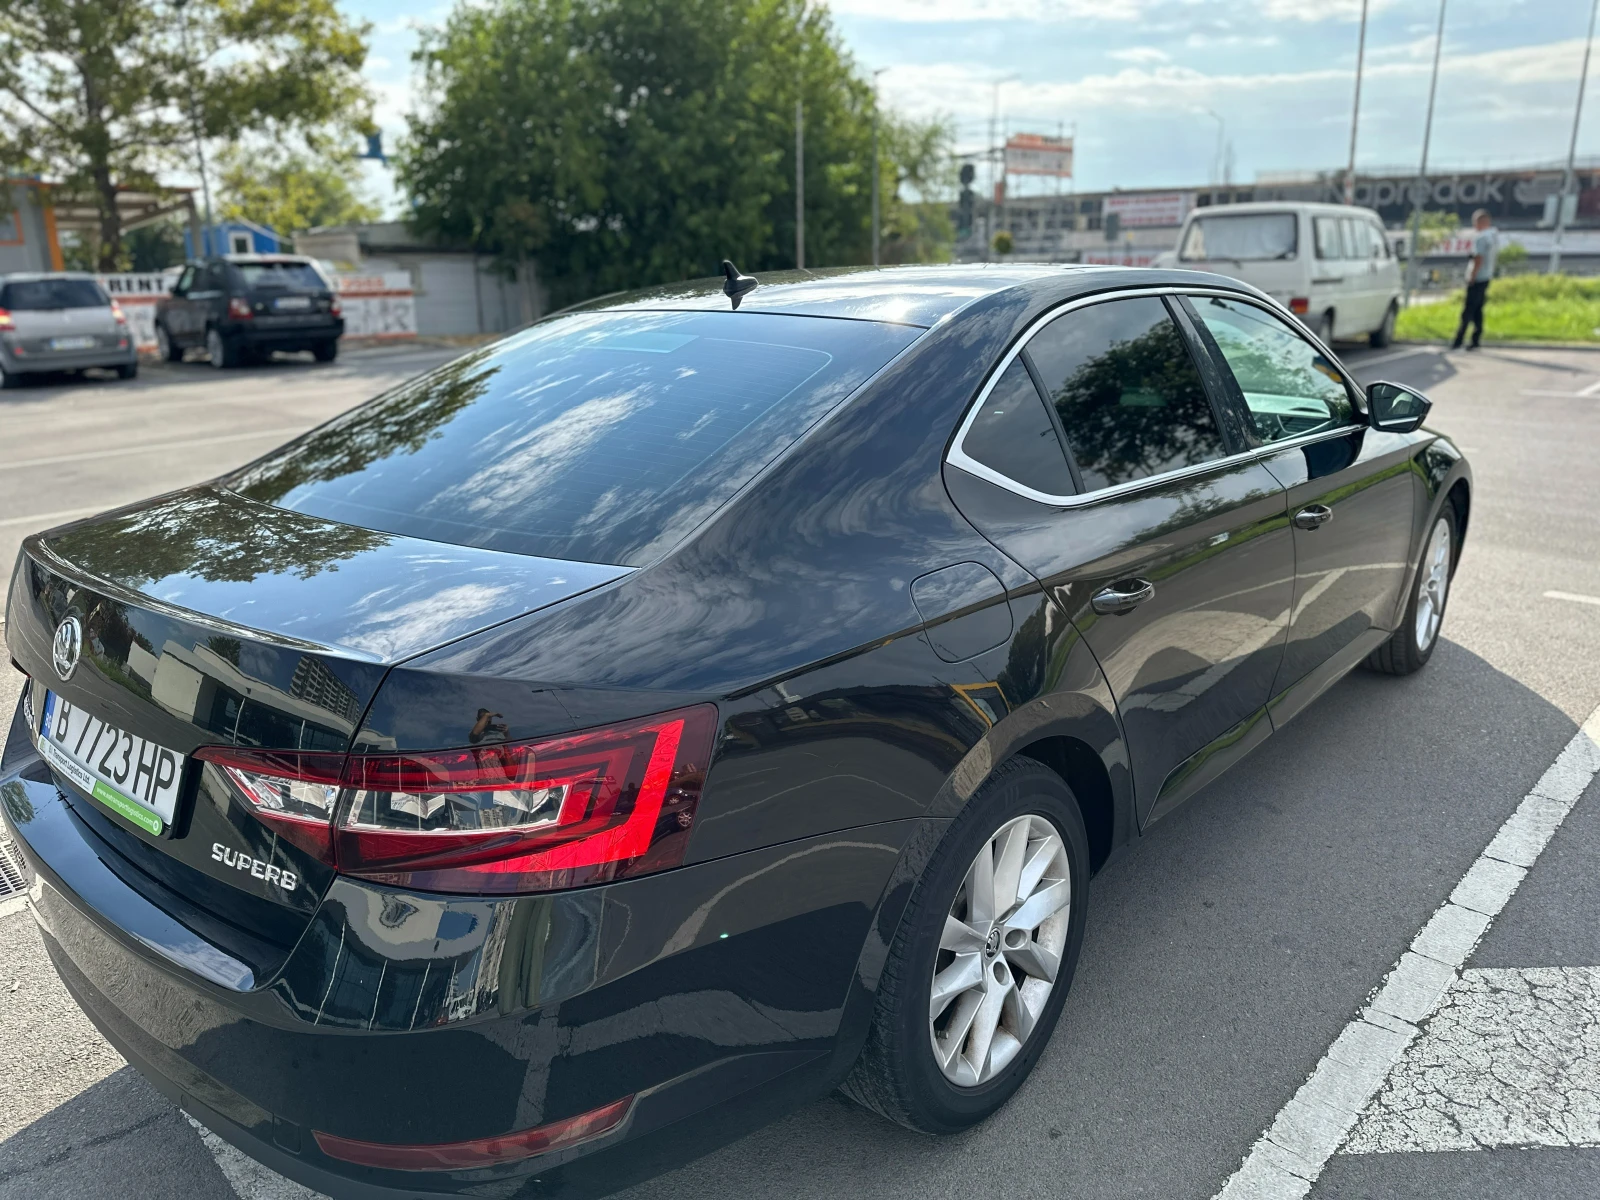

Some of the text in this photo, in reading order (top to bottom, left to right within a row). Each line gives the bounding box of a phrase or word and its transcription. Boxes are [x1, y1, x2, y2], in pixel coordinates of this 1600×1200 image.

[56, 700, 71, 743] B
[132, 739, 176, 806] HP
[211, 842, 299, 891] SUPERB
